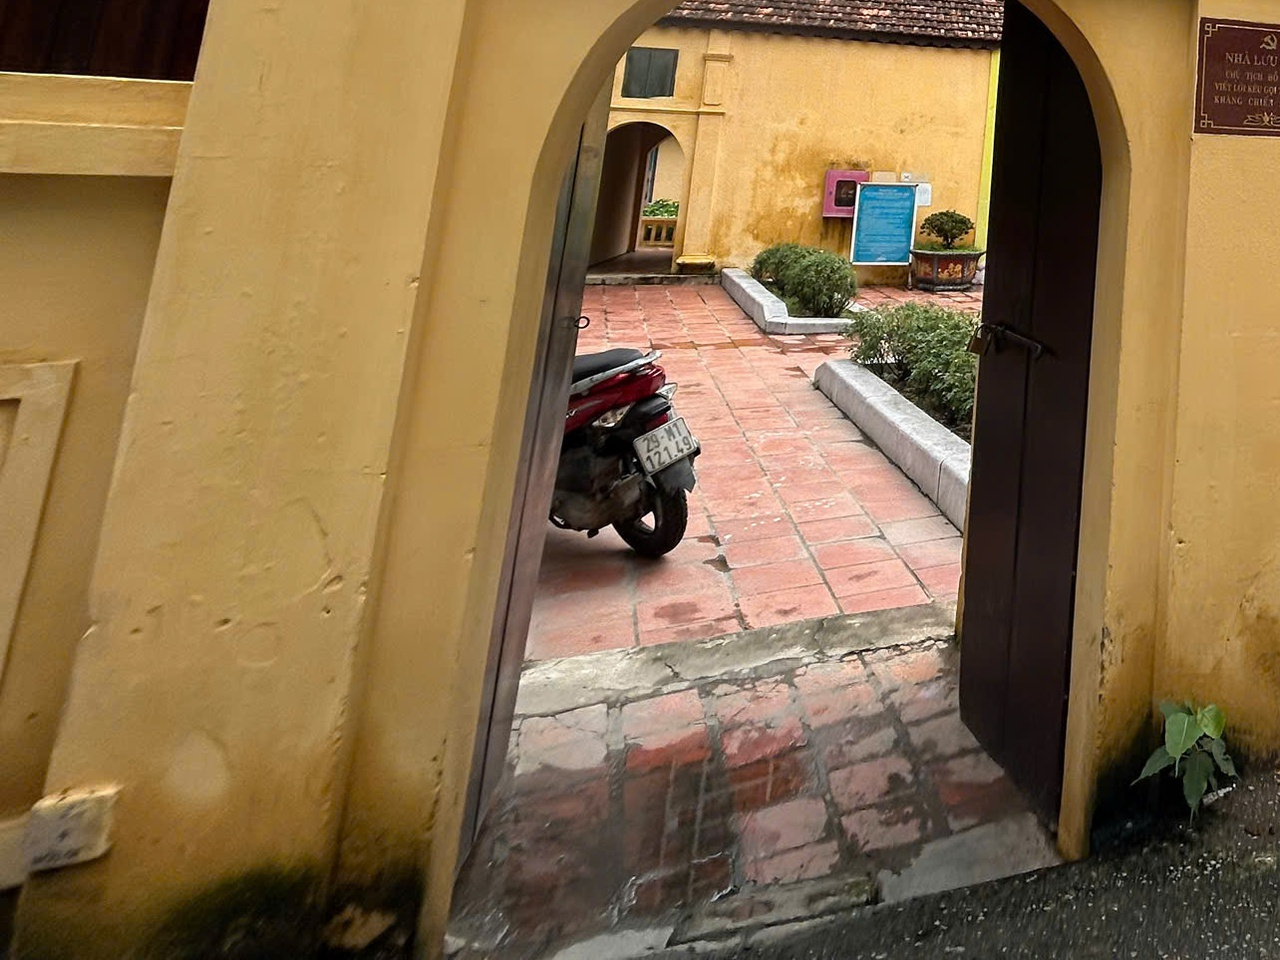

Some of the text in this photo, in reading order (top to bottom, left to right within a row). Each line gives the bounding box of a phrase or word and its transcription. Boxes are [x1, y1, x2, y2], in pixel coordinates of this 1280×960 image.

[1225, 51, 1251, 65] NHÀ
[1254, 54, 1278, 67] LƯU
[642, 422, 682, 453] 29-M1
[646, 436, 693, 470] 121.49
